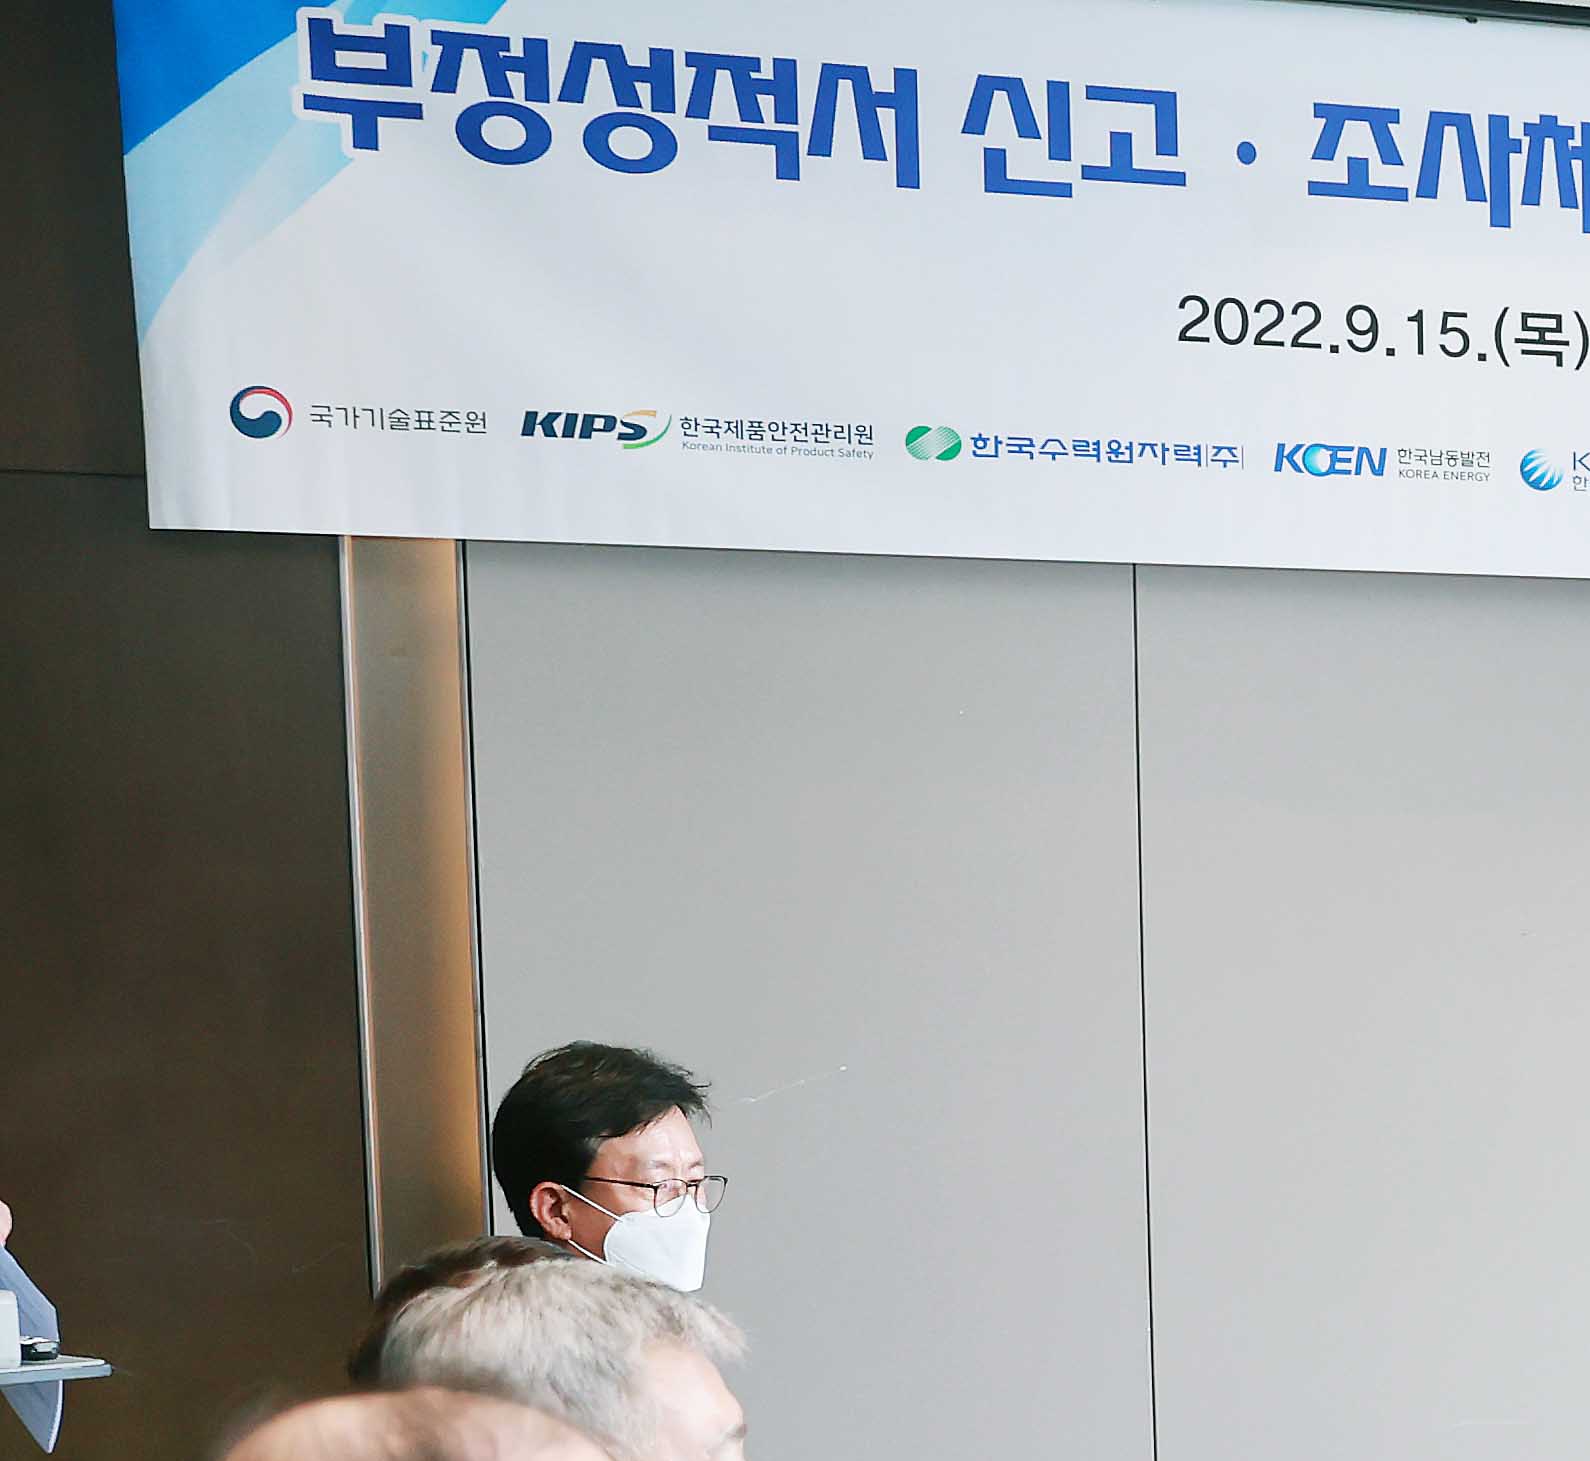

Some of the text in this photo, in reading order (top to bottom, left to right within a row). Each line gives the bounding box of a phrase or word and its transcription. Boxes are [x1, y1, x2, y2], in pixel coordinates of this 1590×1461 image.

[303, 17, 920, 190] 부정성적서
[960, 74, 1187, 198] 신고
[1178, 295, 1590, 373] 2022.9.15.(목)
[309, 404, 487, 434] 국가기술표준원
[520, 410, 672, 450] KIPS
[680, 416, 874, 447] 한국제품안전관리원
[683, 441, 874, 460] Korean Institute of Product Safety
[1274, 442, 1387, 478] KOEN
[1397, 447, 1490, 469] 한국남동발전
[1399, 469, 1490, 482] KOREA ENERGY
